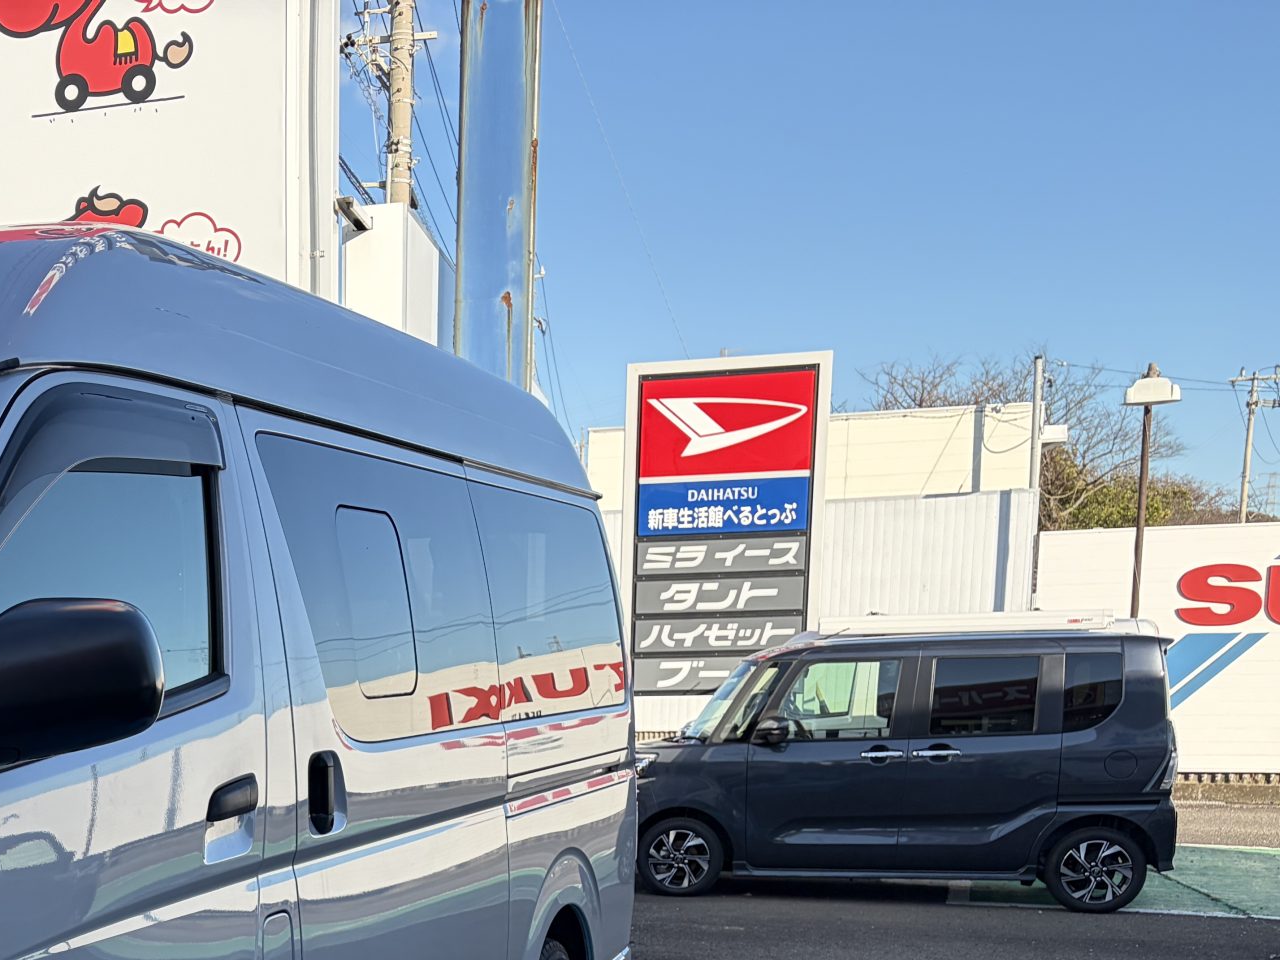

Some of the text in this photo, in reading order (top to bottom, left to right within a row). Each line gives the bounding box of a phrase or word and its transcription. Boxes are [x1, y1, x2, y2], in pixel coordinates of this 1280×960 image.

[687, 486, 758, 502] DAIHATSU
[647, 502, 798, 531] 新車生活館べるとっぷ
[642, 541, 800, 570] ミラ イース
[660, 581, 779, 611] タント
[1174, 563, 1280, 627] S
[639, 622, 796, 649] ハイゼット
[656, 660, 730, 688] ブー
